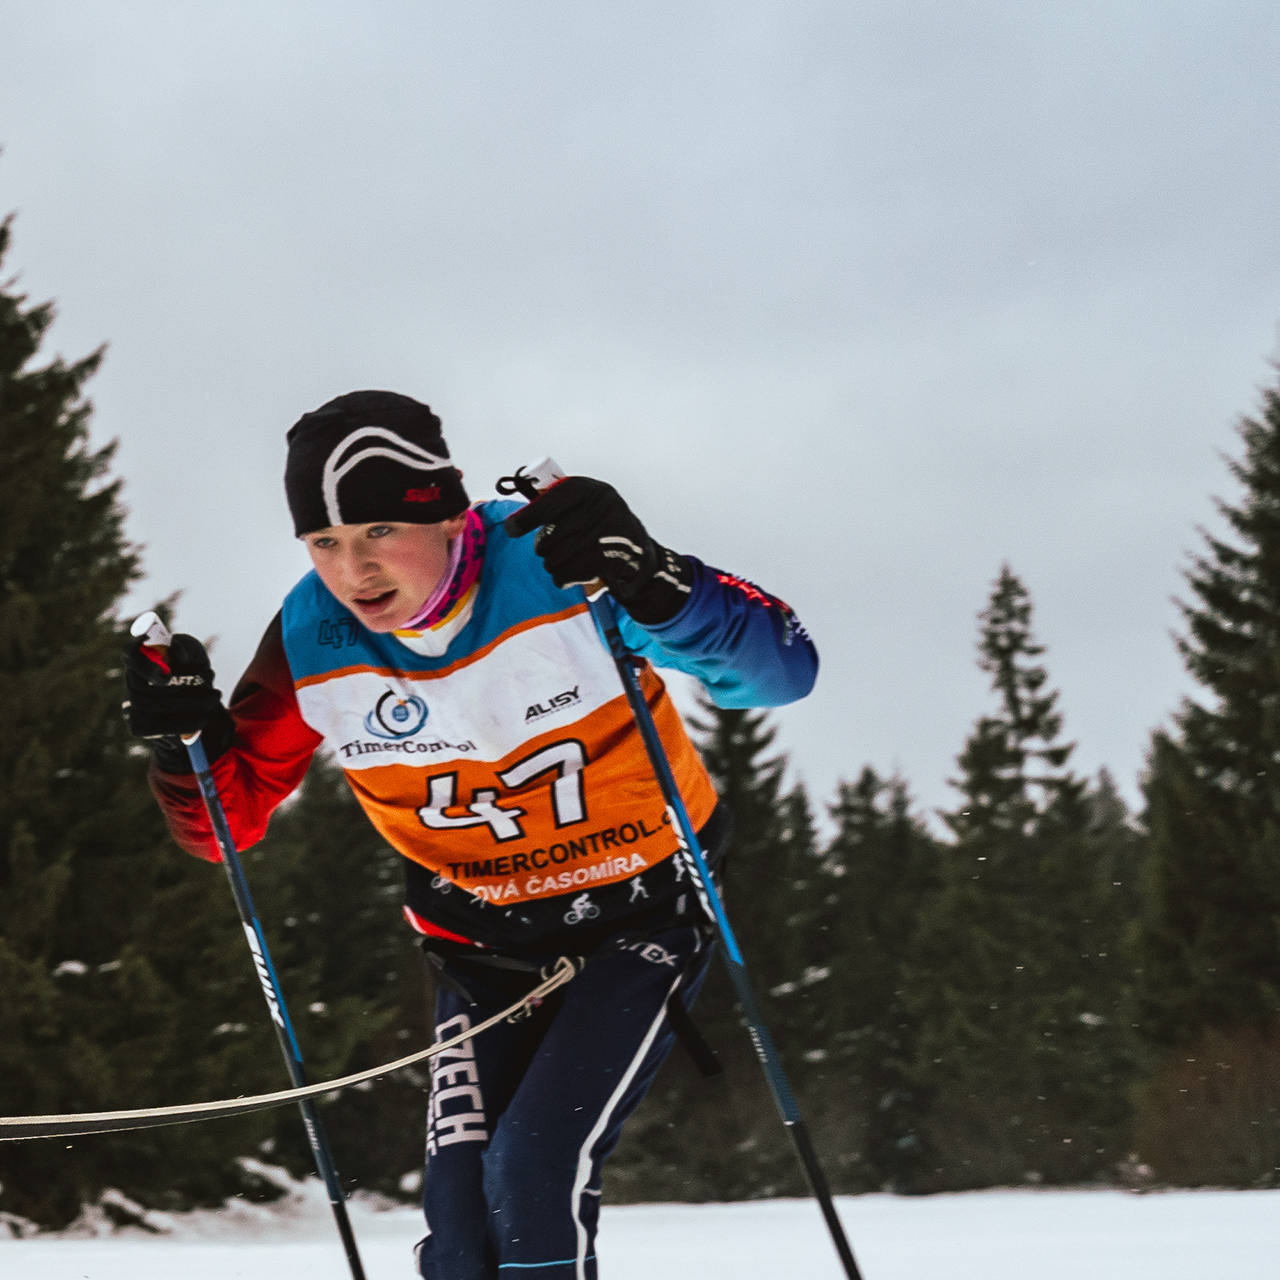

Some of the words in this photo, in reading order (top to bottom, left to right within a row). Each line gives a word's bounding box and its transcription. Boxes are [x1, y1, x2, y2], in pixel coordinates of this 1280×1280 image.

[525, 685, 579, 720] ALISY
[416, 737, 590, 844] 47
[525, 852, 649, 896] ČASOMÍRA
